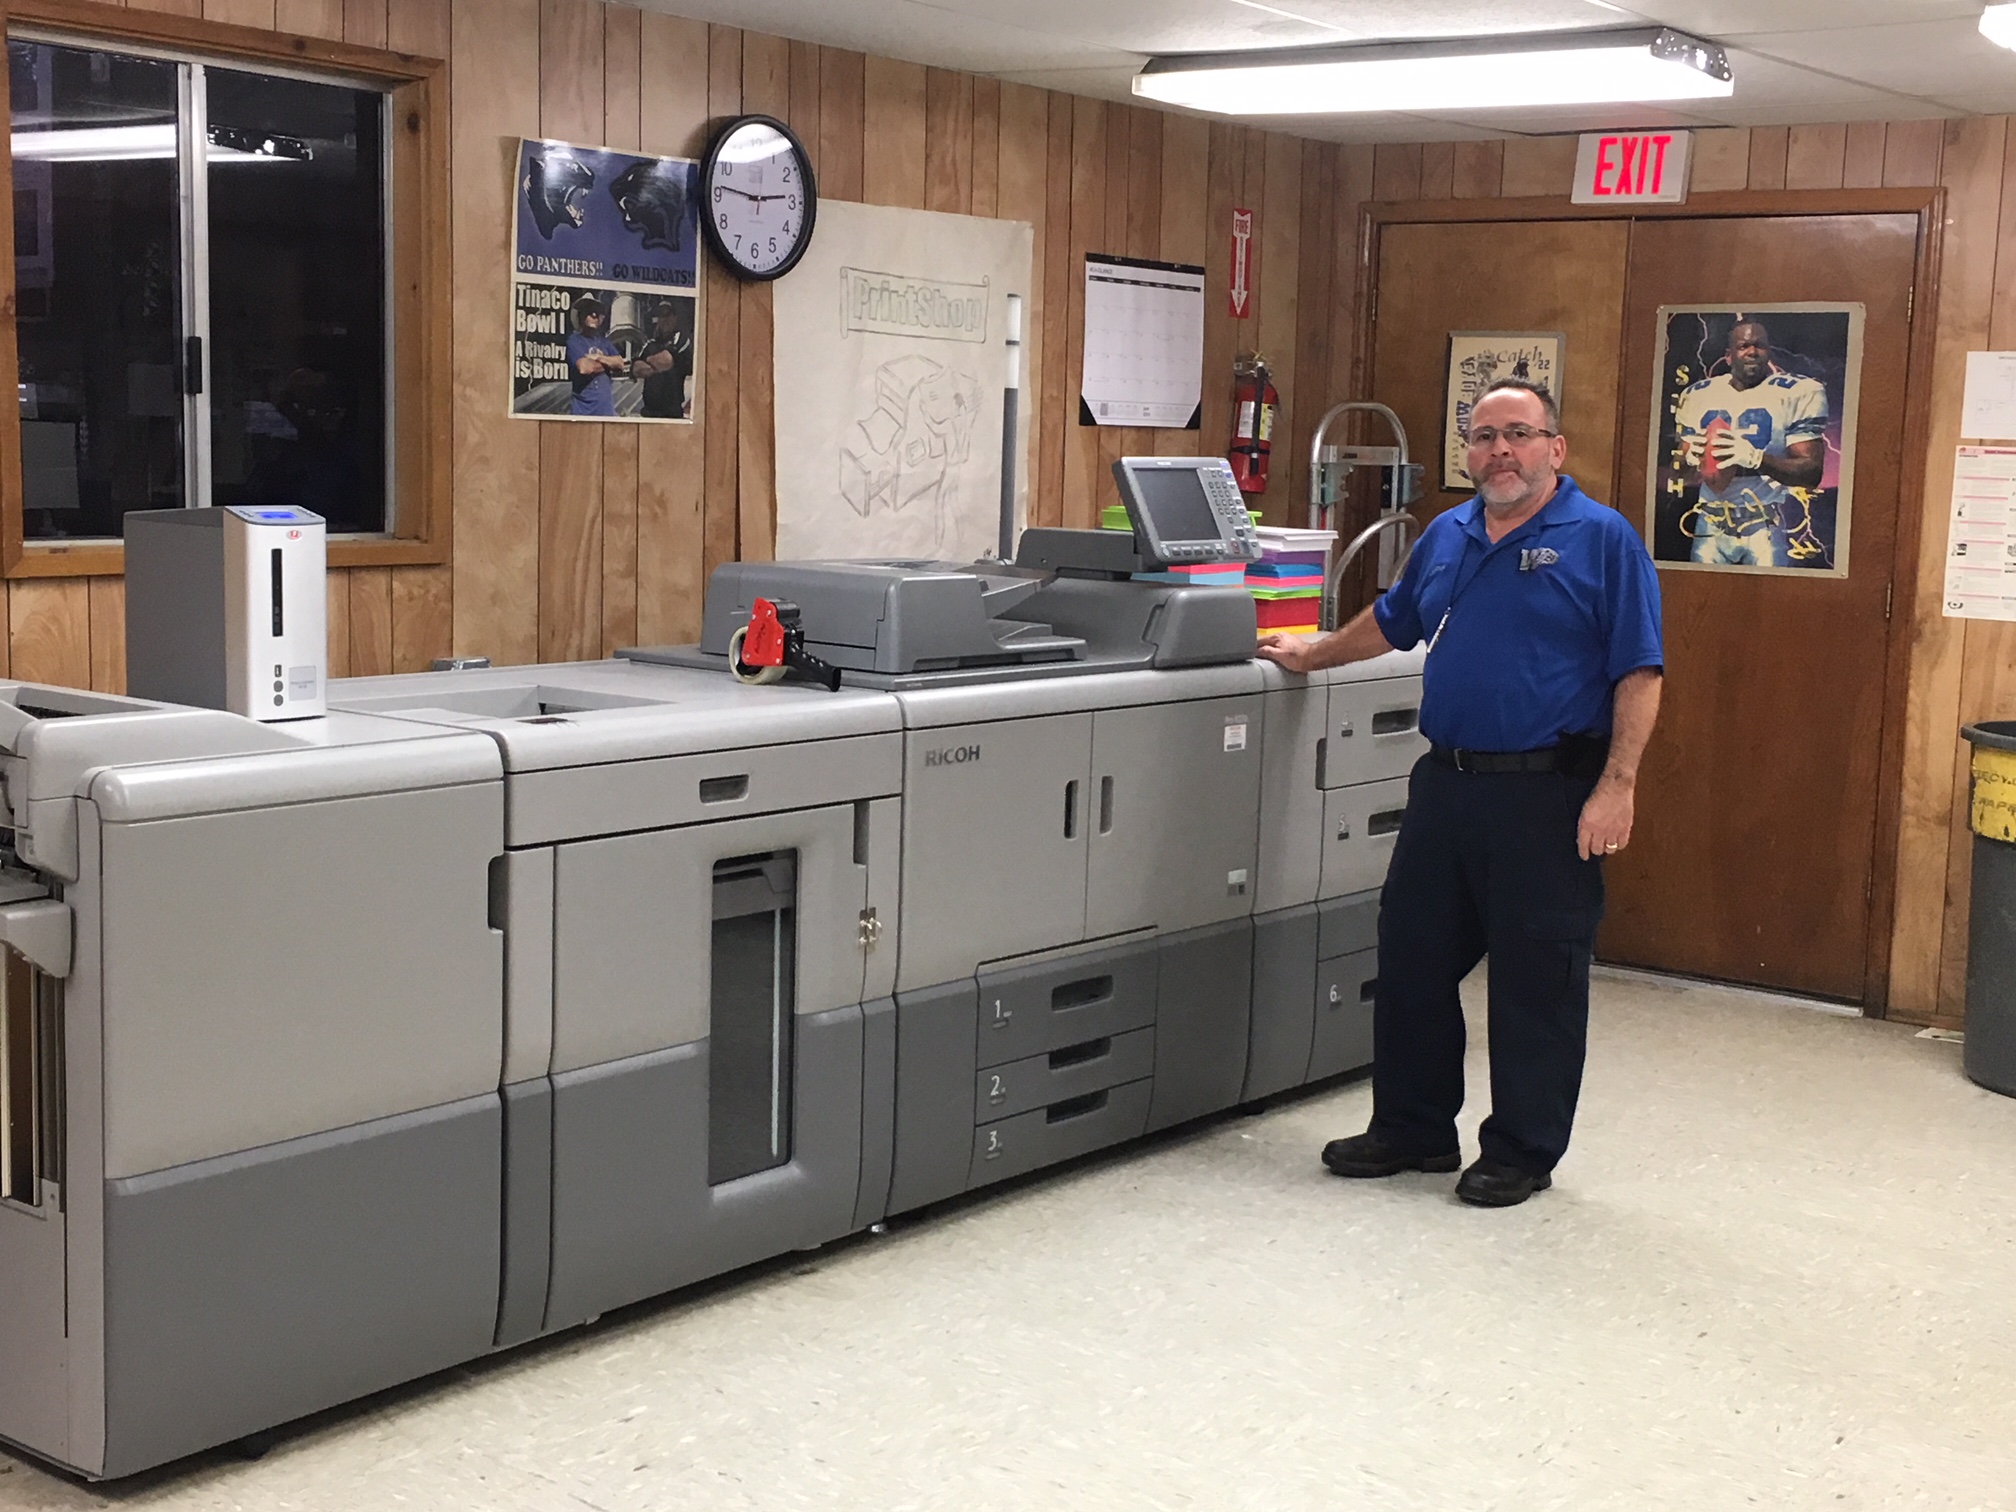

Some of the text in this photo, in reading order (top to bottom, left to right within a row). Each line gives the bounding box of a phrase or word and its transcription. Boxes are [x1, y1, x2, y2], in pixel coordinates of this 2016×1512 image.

[720, 161, 732, 176] 10
[1592, 135, 1673, 195] EXIT
[782, 167, 791, 183] 2
[713, 186, 722, 203] 9
[788, 194, 796, 211] 3
[719, 213, 728, 230] 8
[782, 219, 790, 235] 4
[1235, 218, 1249, 234] FIRE
[733, 234, 742, 250] 7
[750, 242, 759, 259] 6
[768, 237, 777, 253] 5
[518, 254, 603, 276] GO PANTHERS!!
[613, 263, 629, 278] GO
[517, 285, 571, 311] Tinaco
[853, 276, 982, 332] PrintShop
[517, 309, 556, 334] Bowl
[515, 340, 567, 361] A Rivalry
[1496, 345, 1542, 367] Catch
[515, 357, 569, 380] is Born
[1537, 359, 1550, 370] 22
[925, 745, 980, 767] RICOH
[1330, 984, 1337, 1002] 6
[995, 999, 1001, 1018] 1
[990, 1075, 1000, 1096] 2
[988, 1130, 997, 1151] 3
